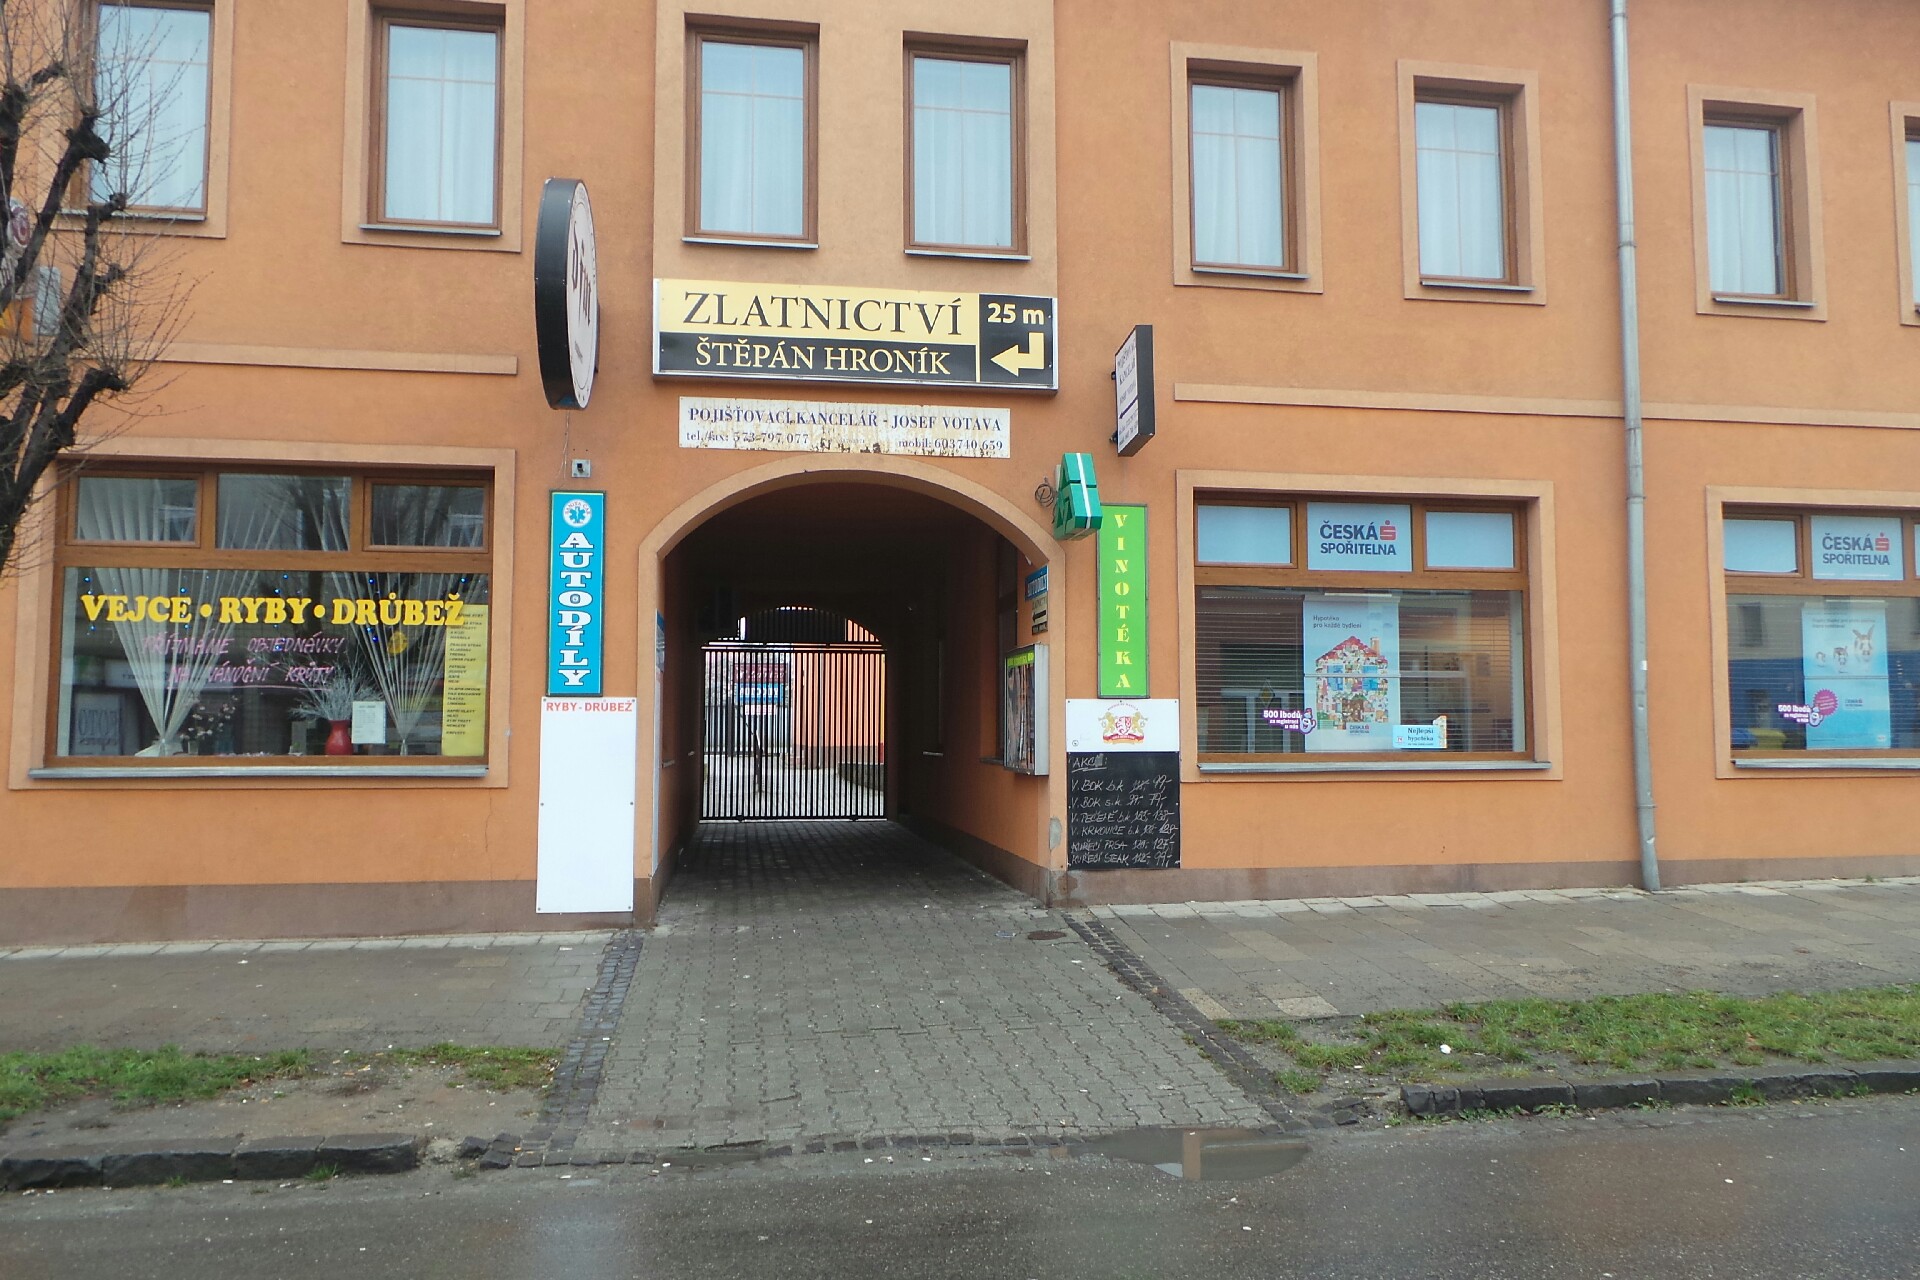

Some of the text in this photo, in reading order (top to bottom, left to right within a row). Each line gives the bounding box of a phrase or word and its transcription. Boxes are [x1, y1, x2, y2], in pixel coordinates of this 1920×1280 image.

[683, 291, 962, 336] ZLATNICTVÍ
[987, 303, 1045, 326] 25 m
[695, 337, 951, 375] ŠTĚPÁN HRONÍK
[689, 405, 791, 424] POJIŠŤOVACÍ
[797, 410, 878, 426] KANCELÁŘ
[892, 414, 937, 429] JOSEF
[943, 417, 1001, 431] VOTAVA
[1320, 520, 1378, 540] ČESKÁ
[1320, 541, 1397, 555] SPOŘITELNA
[1822, 532, 1874, 551] ČESKÁ
[1822, 552, 1891, 566] SPOŘITELNA
[80, 592, 466, 626] VEJCE RYBY DRŮBEŽ
[557, 531, 594, 686] AUTODÍLY
[1114, 514, 1133, 688] VINOTÉKA
[546, 702, 577, 712] RYBY
[585, 699, 633, 712] DRŮBEŽ
[1263, 710, 1279, 718] 500
[1778, 705, 1791, 713] 500
